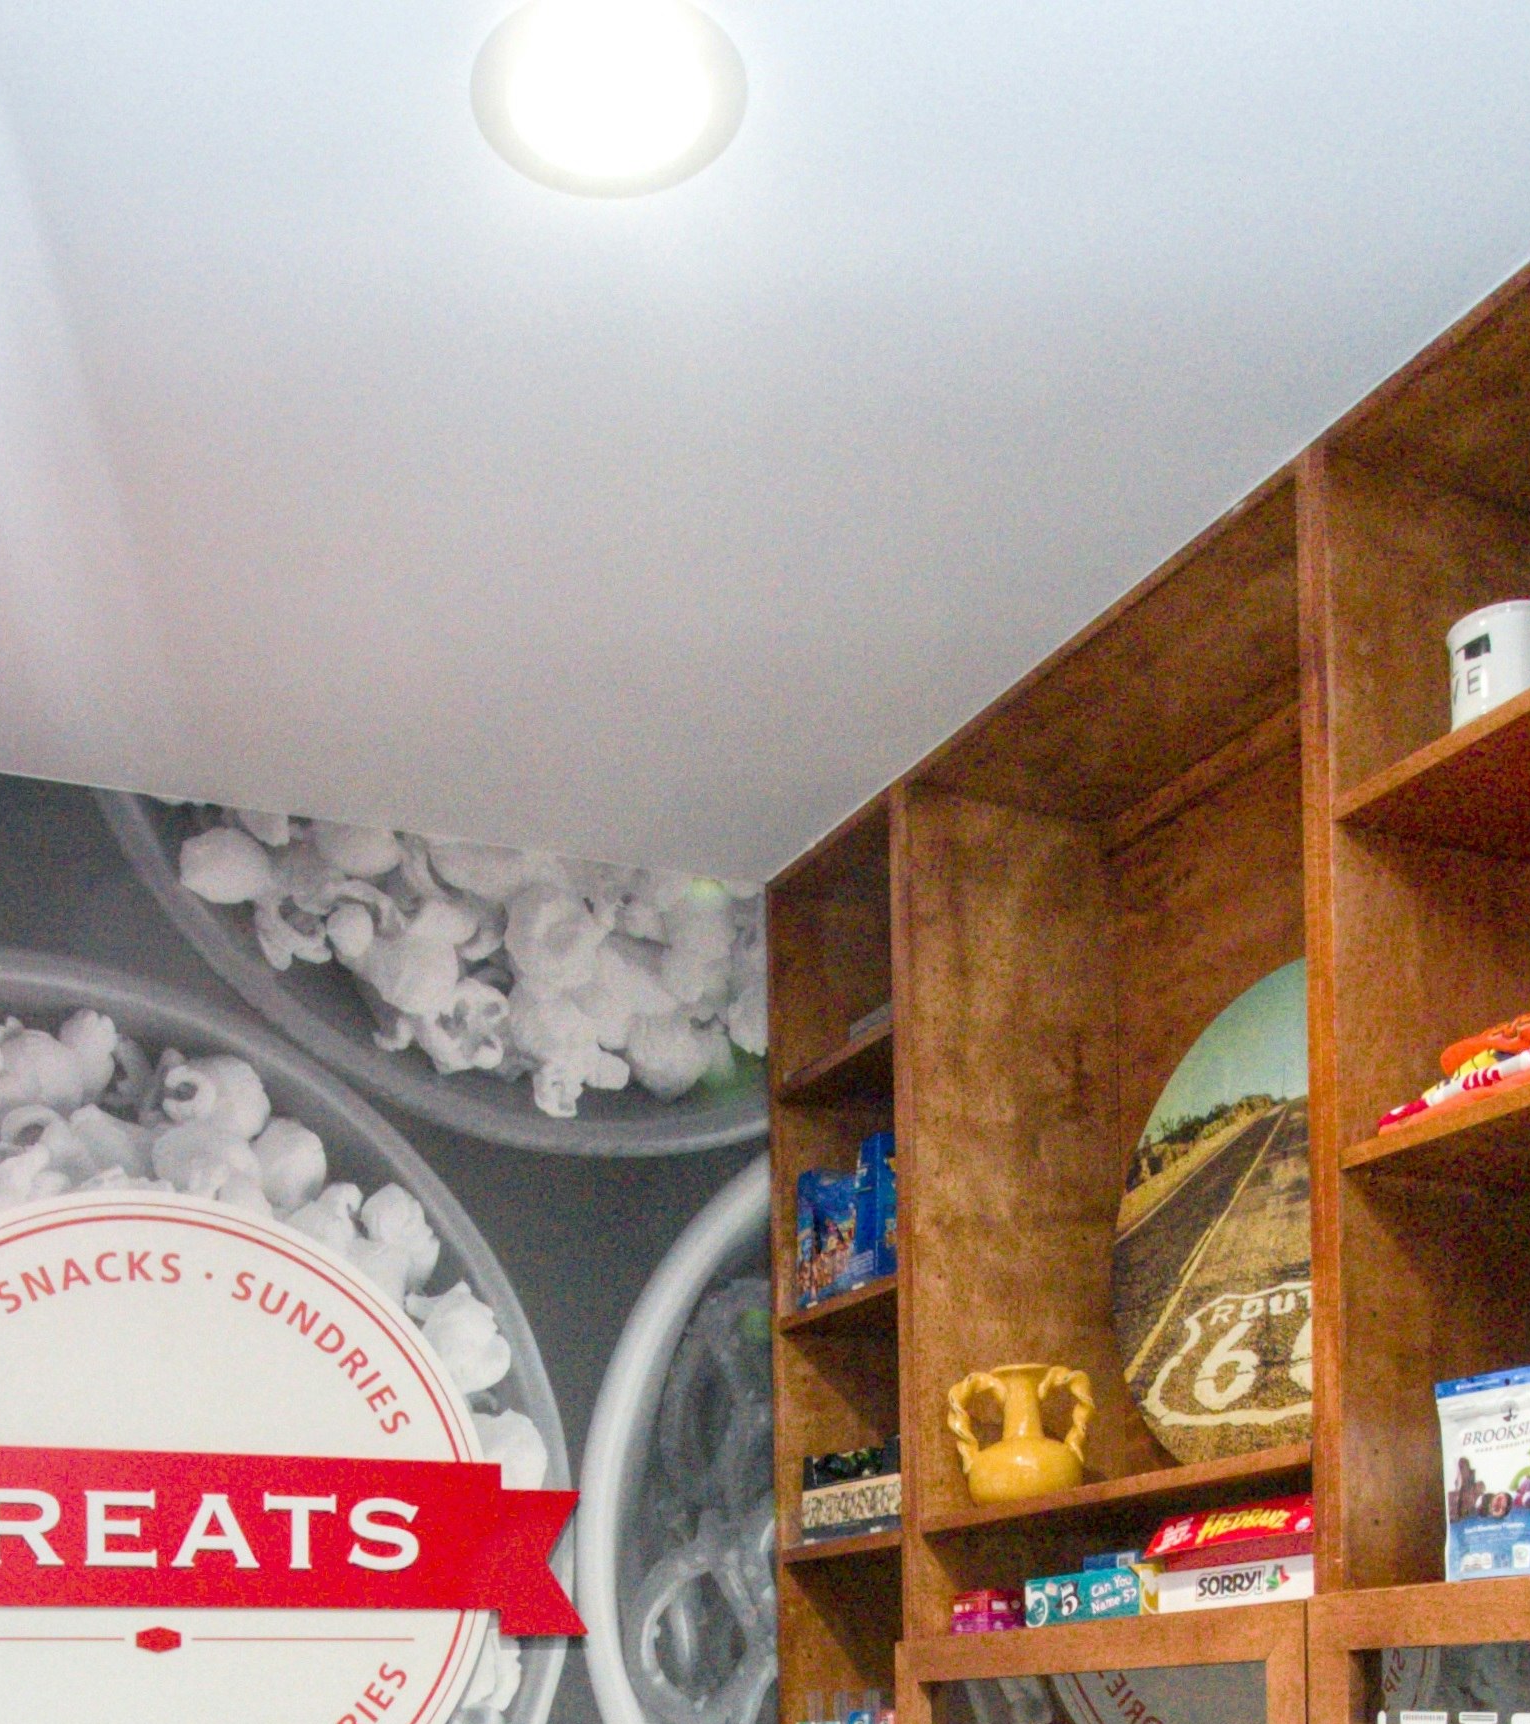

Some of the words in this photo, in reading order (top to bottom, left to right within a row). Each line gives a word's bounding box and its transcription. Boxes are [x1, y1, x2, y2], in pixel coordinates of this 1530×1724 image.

[230, 1270, 412, 1439] SUNDRIES
[1091, 1582, 1112, 1598] Can
[1113, 1574, 1133, 1591] You
[1198, 1570, 1262, 1597] SORRY!
[1090, 1596, 1120, 1614] Name
